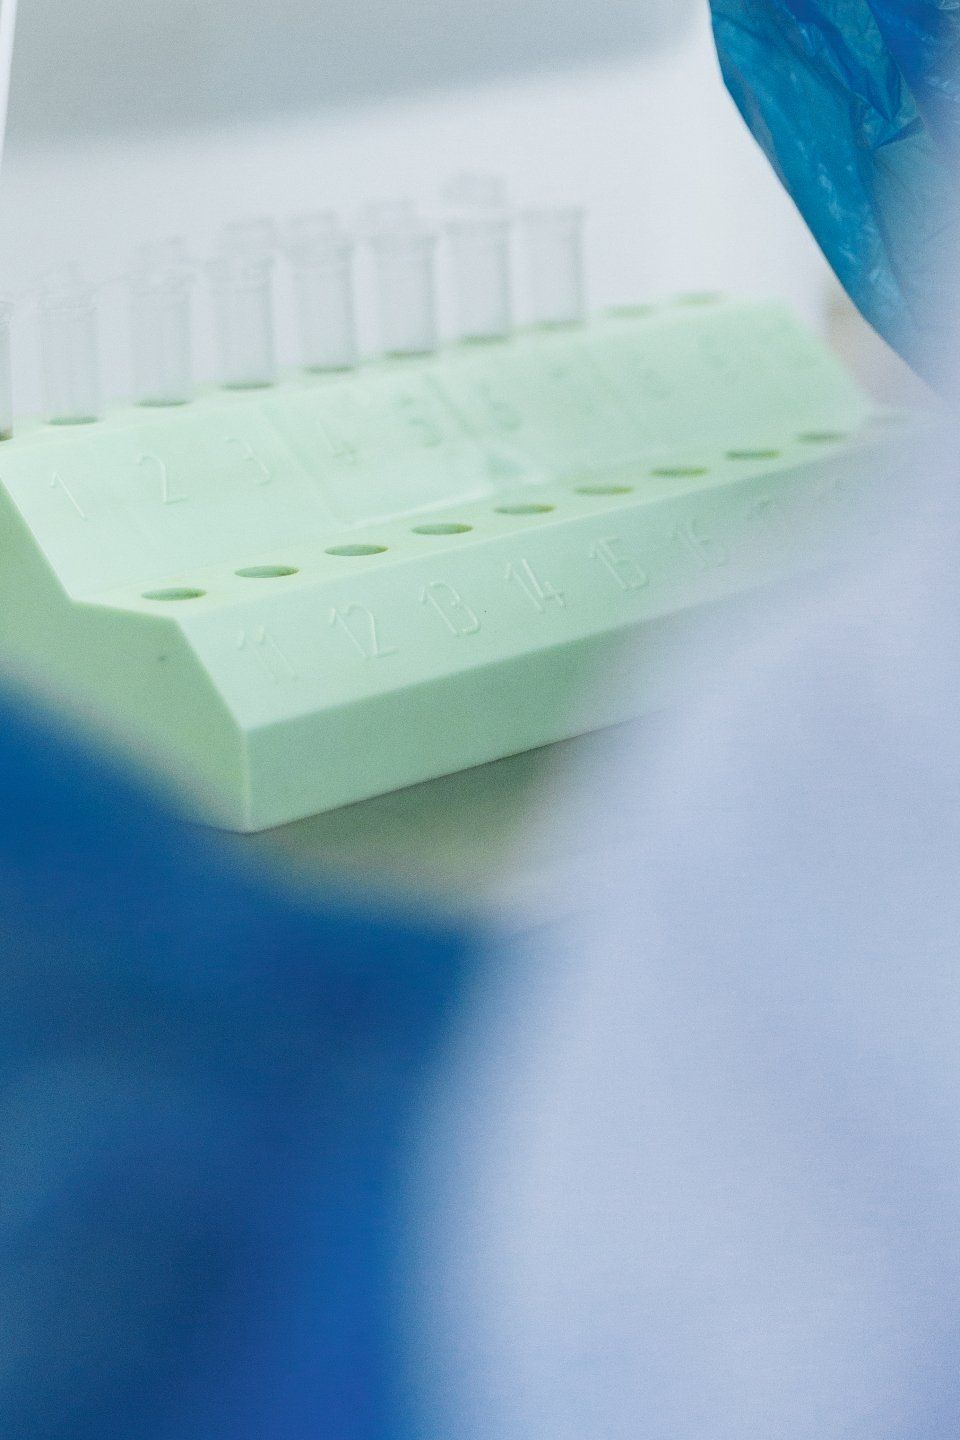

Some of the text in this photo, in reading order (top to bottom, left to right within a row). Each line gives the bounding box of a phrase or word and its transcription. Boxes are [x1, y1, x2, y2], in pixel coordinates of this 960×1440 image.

[49, 469, 88, 521] 1
[136, 452, 189, 506] 2
[223, 433, 276, 488] 3
[315, 417, 359, 466] 4
[234, 624, 300, 685] 11
[327, 603, 399, 662] 12
[418, 580, 481, 637] 13
[503, 557, 566, 612] 14
[589, 535, 649, 591] 15
